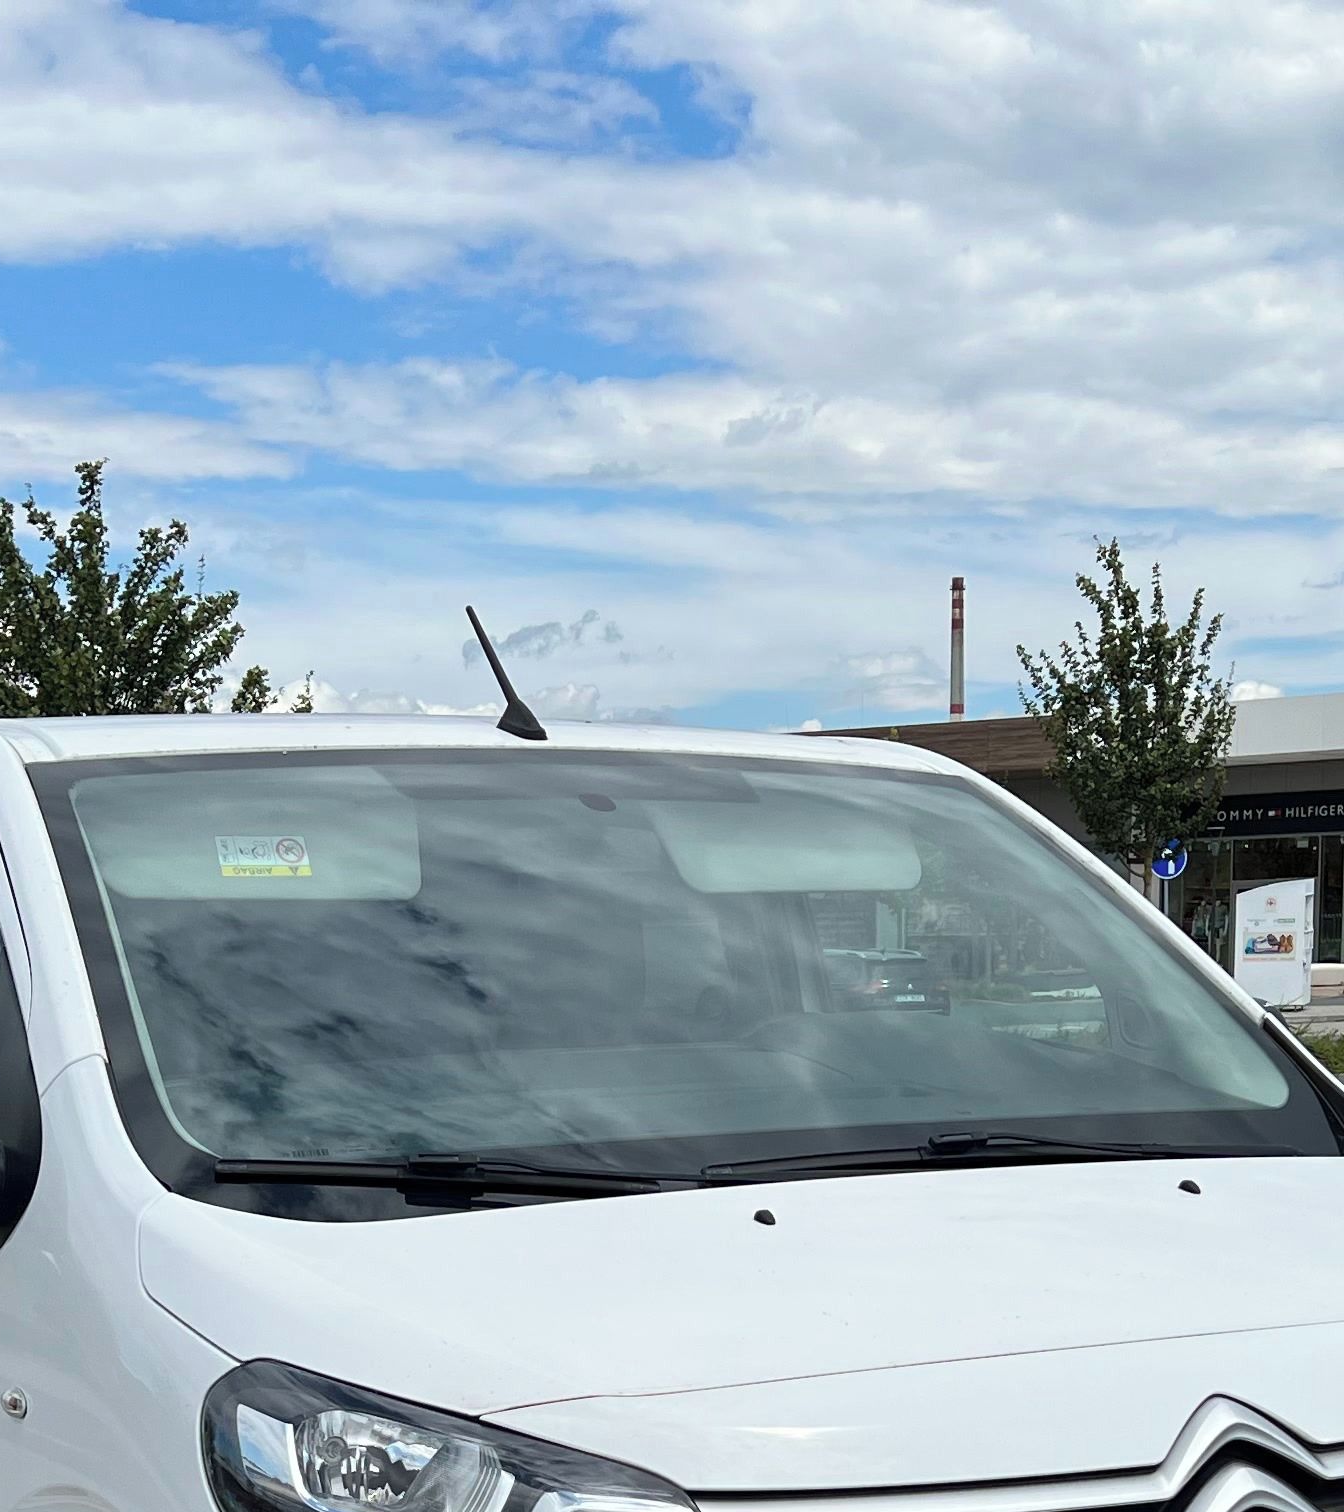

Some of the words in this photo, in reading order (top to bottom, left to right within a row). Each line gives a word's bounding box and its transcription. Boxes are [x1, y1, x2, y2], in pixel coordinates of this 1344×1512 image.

[1216, 808, 1264, 822] OMMY
[1285, 804, 1344, 818] HILFIGER
[232, 867, 273, 875] AIRBAG
